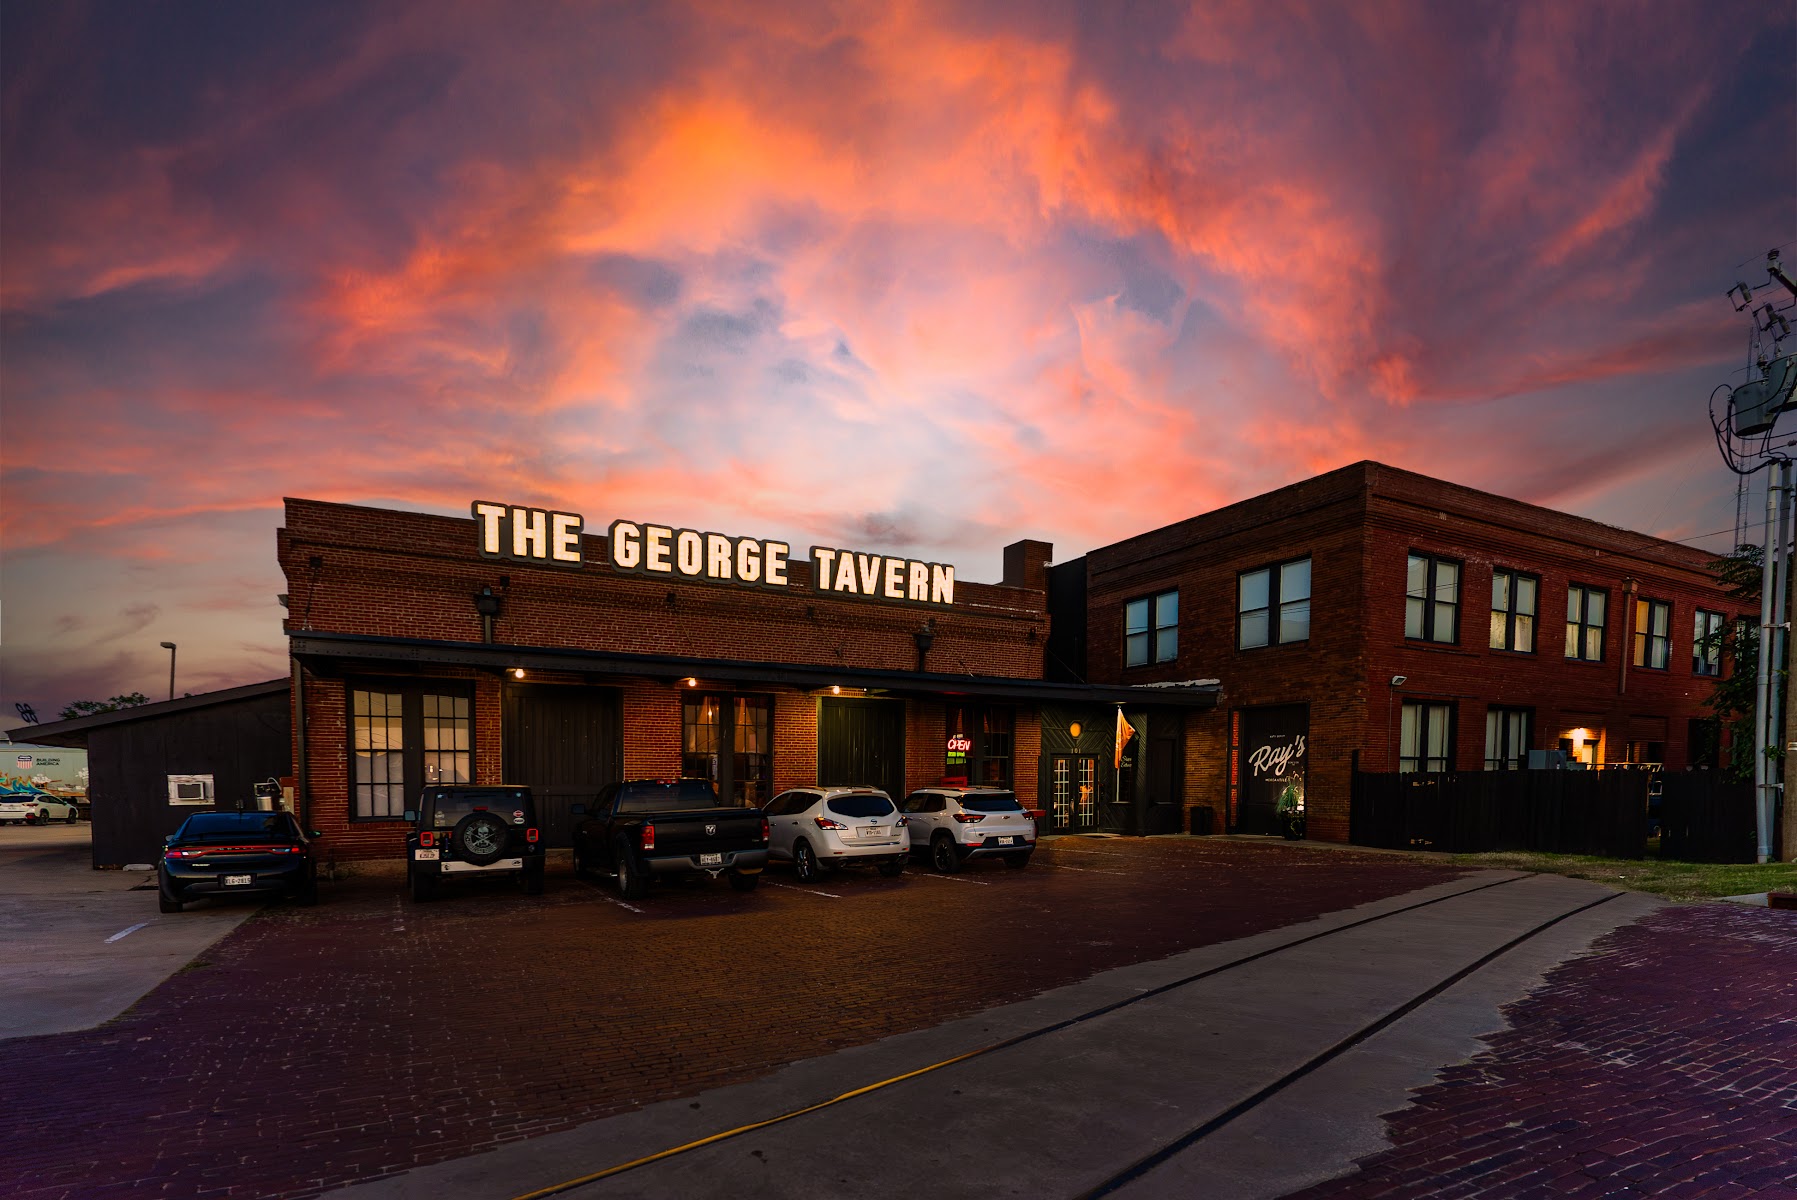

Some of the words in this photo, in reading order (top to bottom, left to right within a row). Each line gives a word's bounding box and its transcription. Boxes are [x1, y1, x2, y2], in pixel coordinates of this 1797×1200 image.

[476, 503, 583, 563] THE
[612, 521, 789, 586] GEORGE
[813, 547, 955, 605] TAVERN
[947, 739, 971, 751] OPEN
[1247, 734, 1306, 777] Ray's
